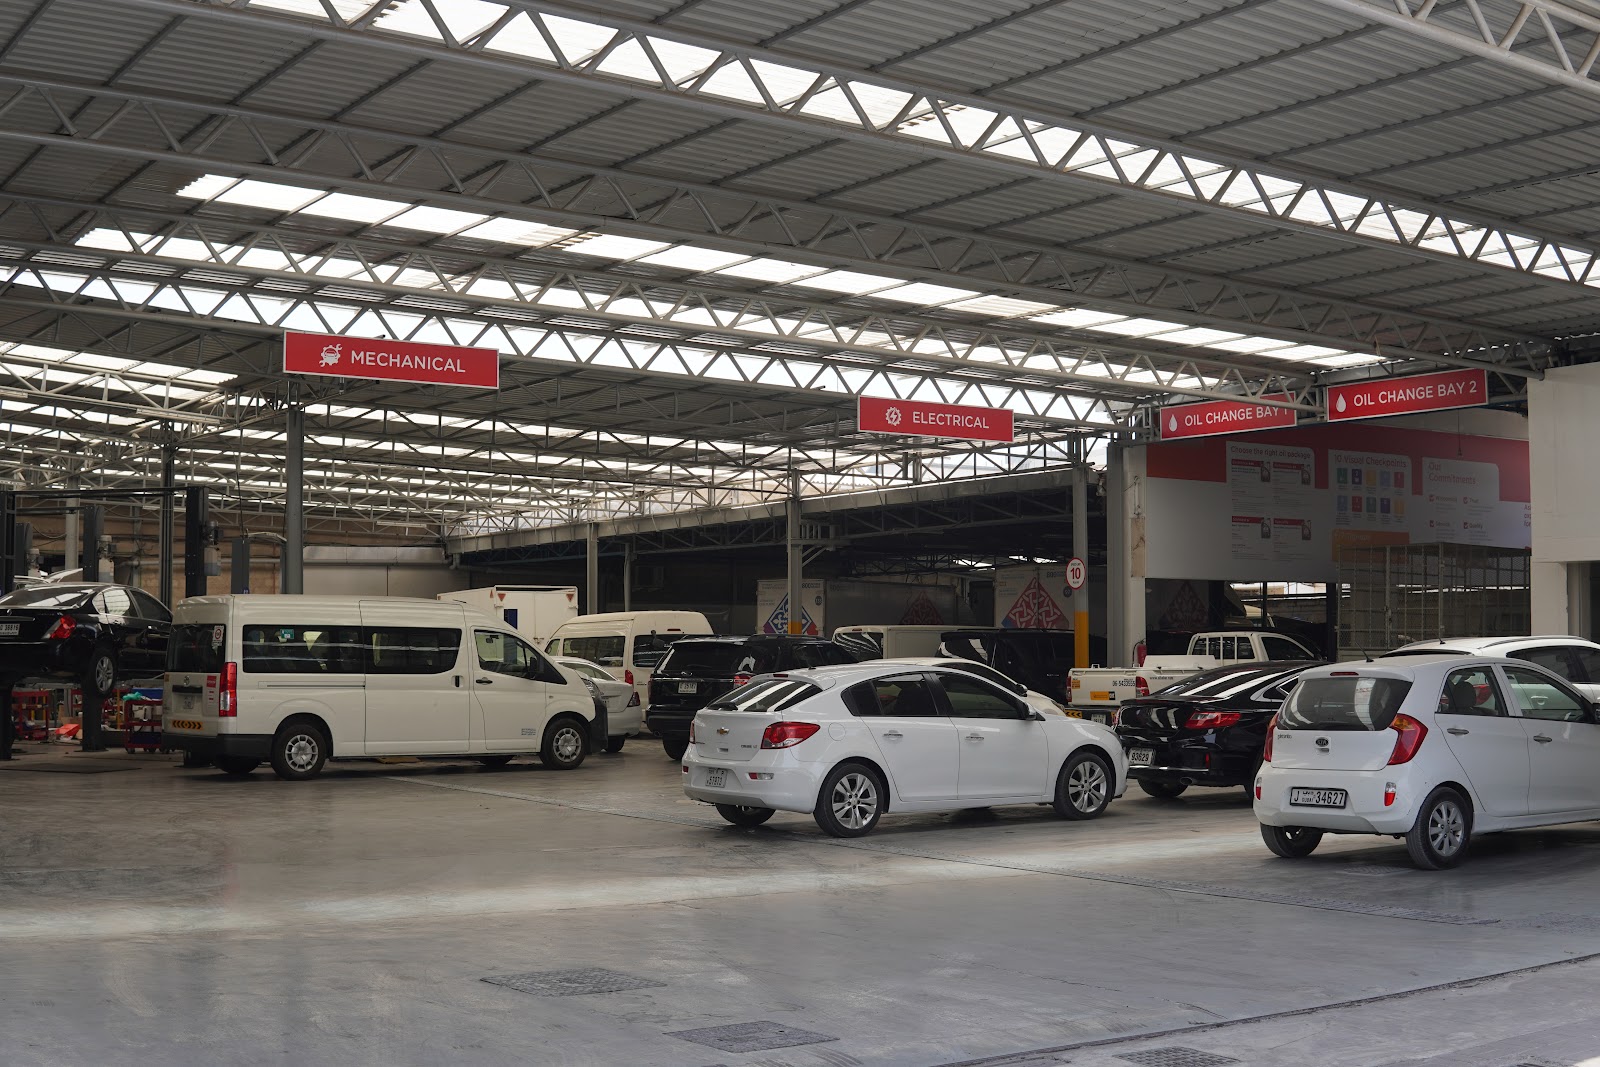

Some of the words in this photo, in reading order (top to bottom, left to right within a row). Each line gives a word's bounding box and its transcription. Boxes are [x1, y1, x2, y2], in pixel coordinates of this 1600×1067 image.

[351, 350, 466, 373] MECHANICAL
[1353, 393, 1375, 407] OIL
[1378, 385, 1434, 404] CHANGE
[1437, 381, 1465, 397] BAY
[1469, 380, 1477, 393] 2
[912, 411, 990, 429] ELECTRICAL
[1184, 414, 1203, 426] OIL
[1205, 407, 1253, 424] CHANGE
[1256, 406, 1279, 418] BAY
[1230, 445, 1253, 454] Choose
[1253, 447, 1264, 455] the
[1264, 448, 1278, 457] right
[1287, 451, 1311, 460] package
[1343, 455, 1364, 464] Visual
[1365, 456, 1407, 468] Checkpoints
[1428, 472, 1476, 485] Commitments
[1070, 567, 1081, 580] 10
[1131, 752, 1150, 762] 93629
[1293, 790, 1300, 802] J
[1315, 791, 1344, 805] 34627
